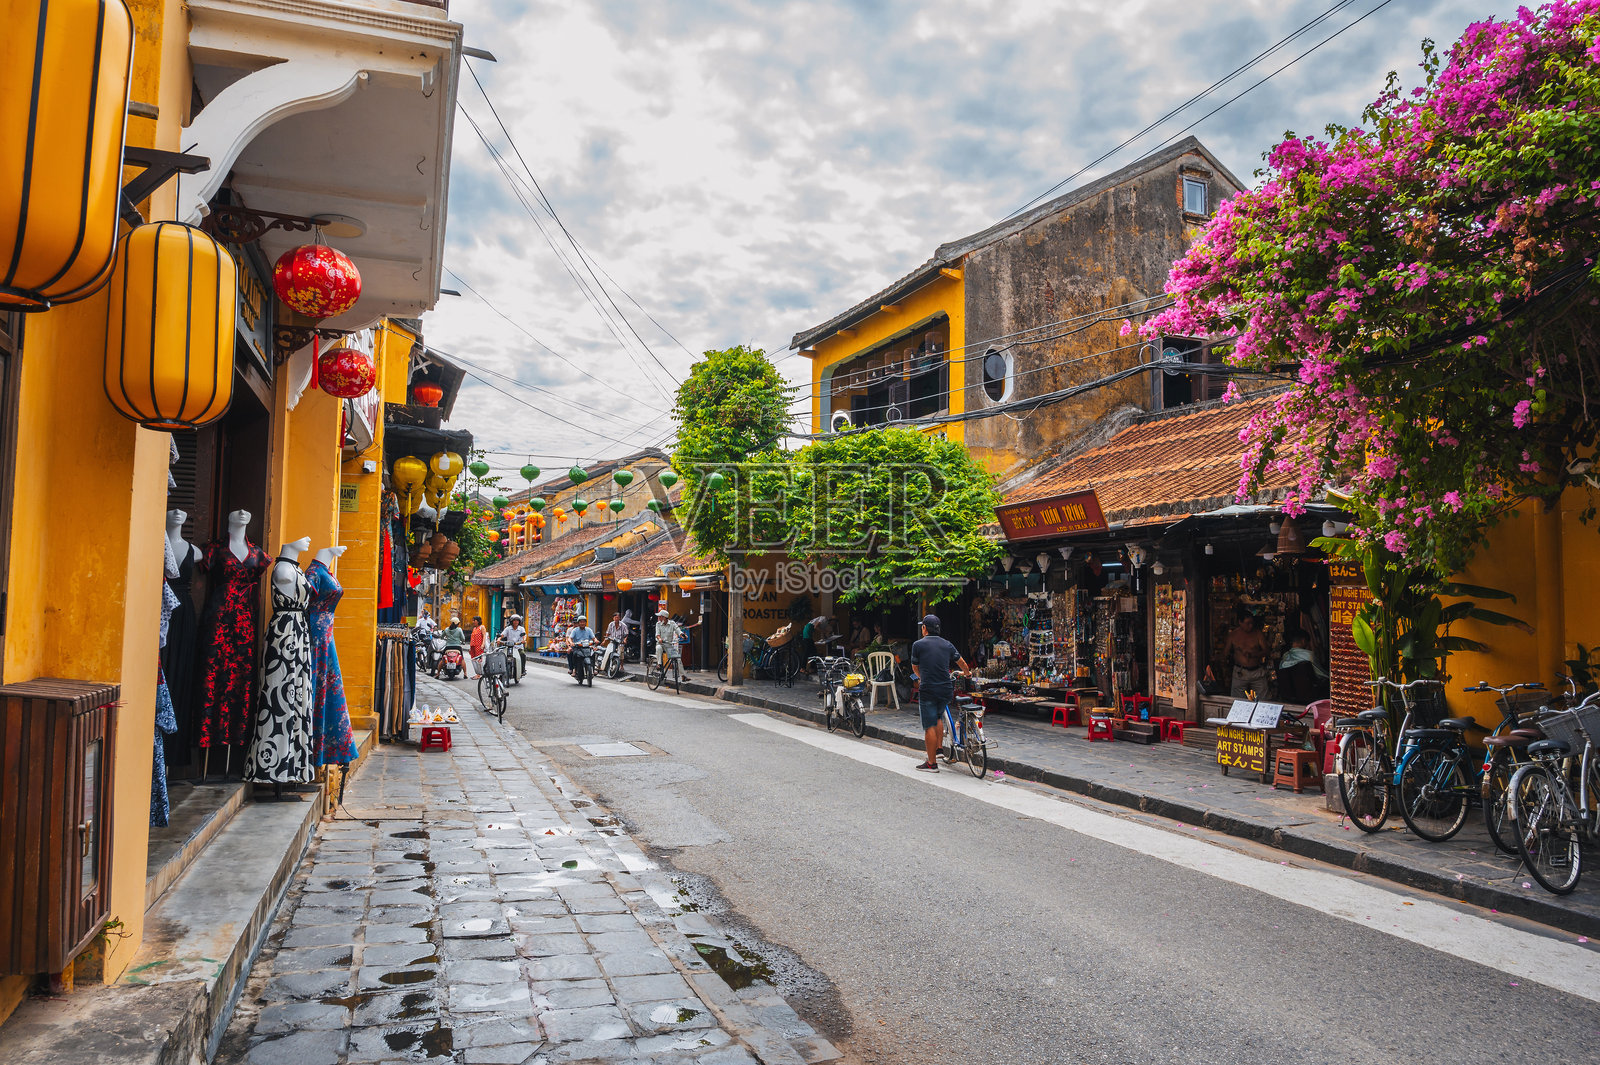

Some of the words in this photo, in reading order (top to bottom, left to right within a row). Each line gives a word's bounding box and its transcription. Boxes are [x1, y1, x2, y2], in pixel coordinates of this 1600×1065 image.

[1329, 566, 1357, 577] はんこ
[762, 591, 777, 602] AN
[1332, 600, 1347, 609] ART
[1229, 729, 1244, 742] NGHỆ
[1245, 731, 1264, 745] THUẬT
[1217, 740, 1232, 752] ART
[1233, 742, 1264, 758] STAMPS
[1217, 752, 1263, 771] はんこ
